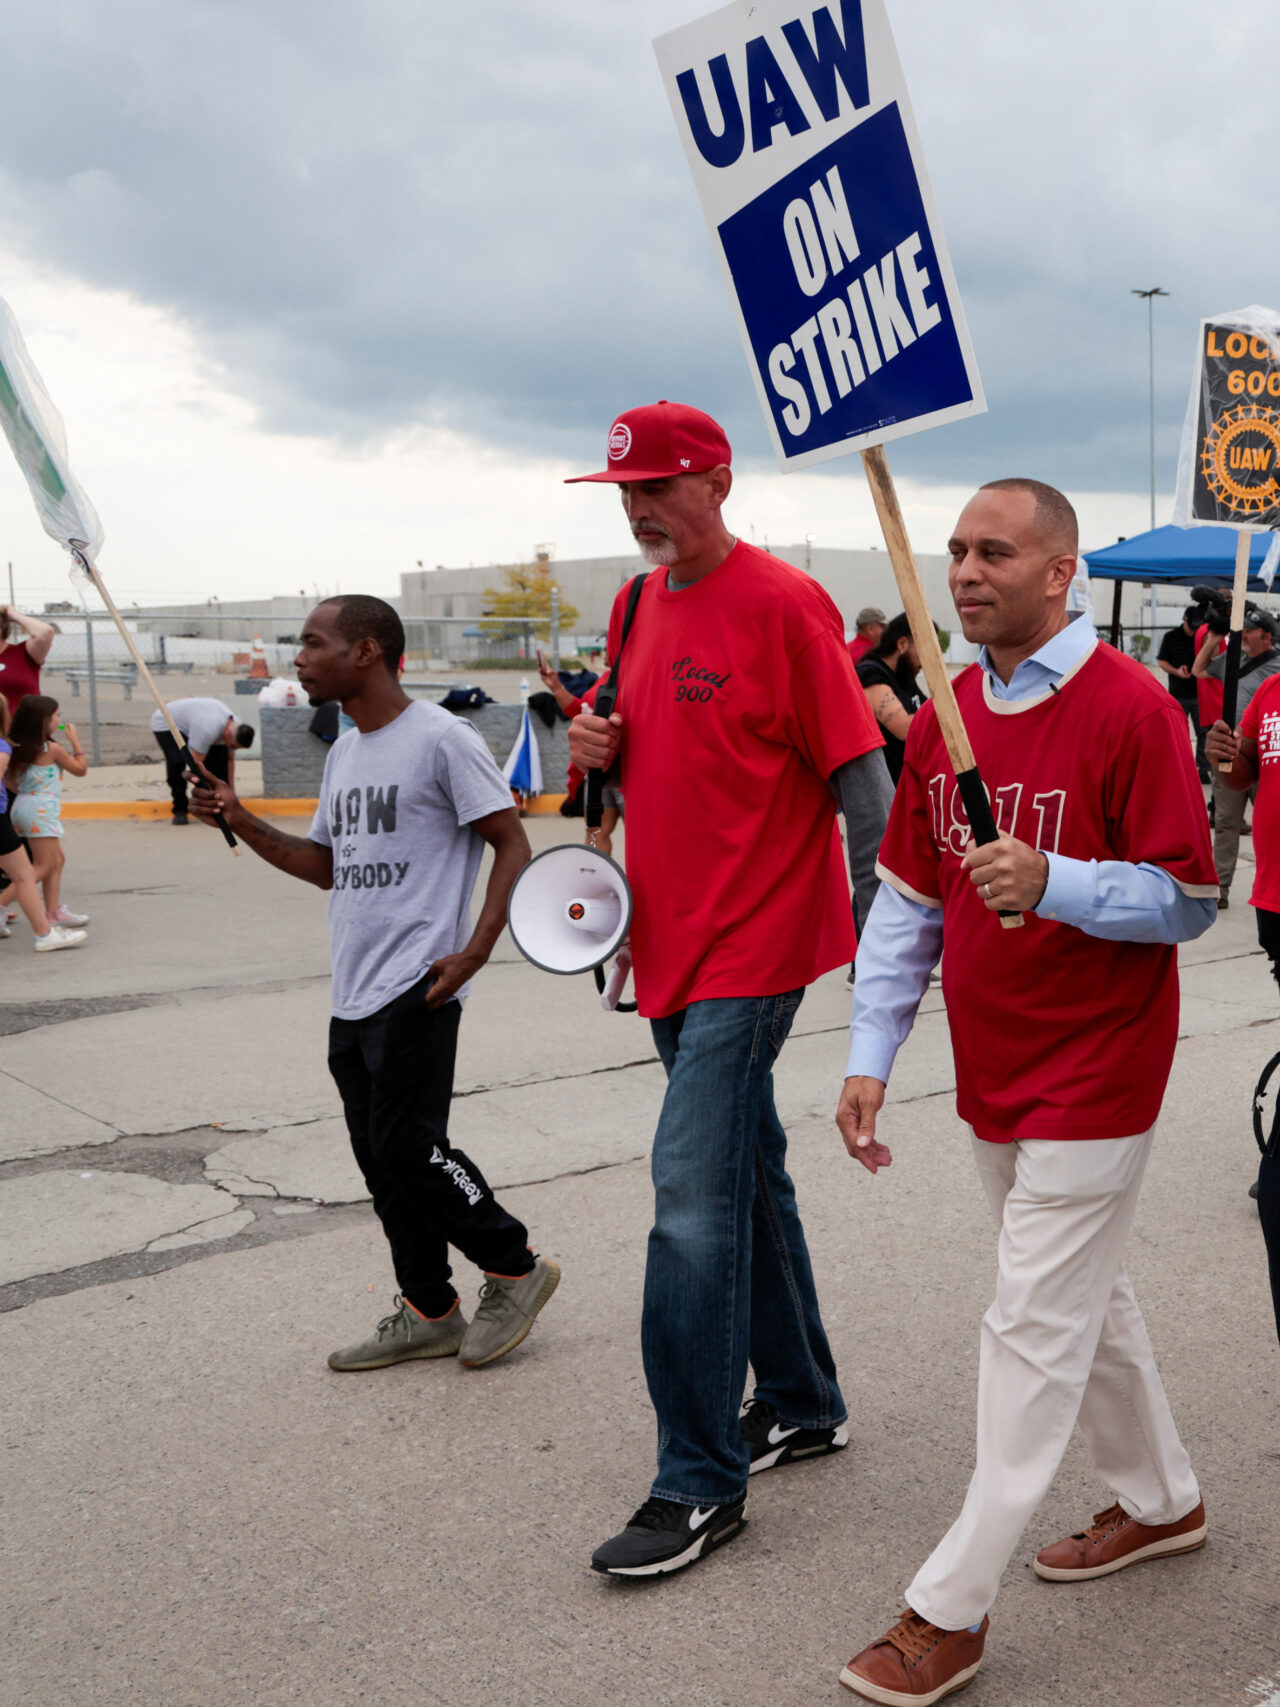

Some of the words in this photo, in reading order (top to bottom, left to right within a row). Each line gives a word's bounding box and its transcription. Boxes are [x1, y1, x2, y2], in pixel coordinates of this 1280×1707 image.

[676, 0, 870, 168] UAW
[783, 164, 860, 297] ON
[768, 230, 942, 437] STRIKE
[1229, 446, 1272, 471] UAW
[671, 657, 731, 689] Local
[675, 685, 714, 703] 900
[330, 785, 398, 837] UAW
[928, 773, 1067, 857] 1911
